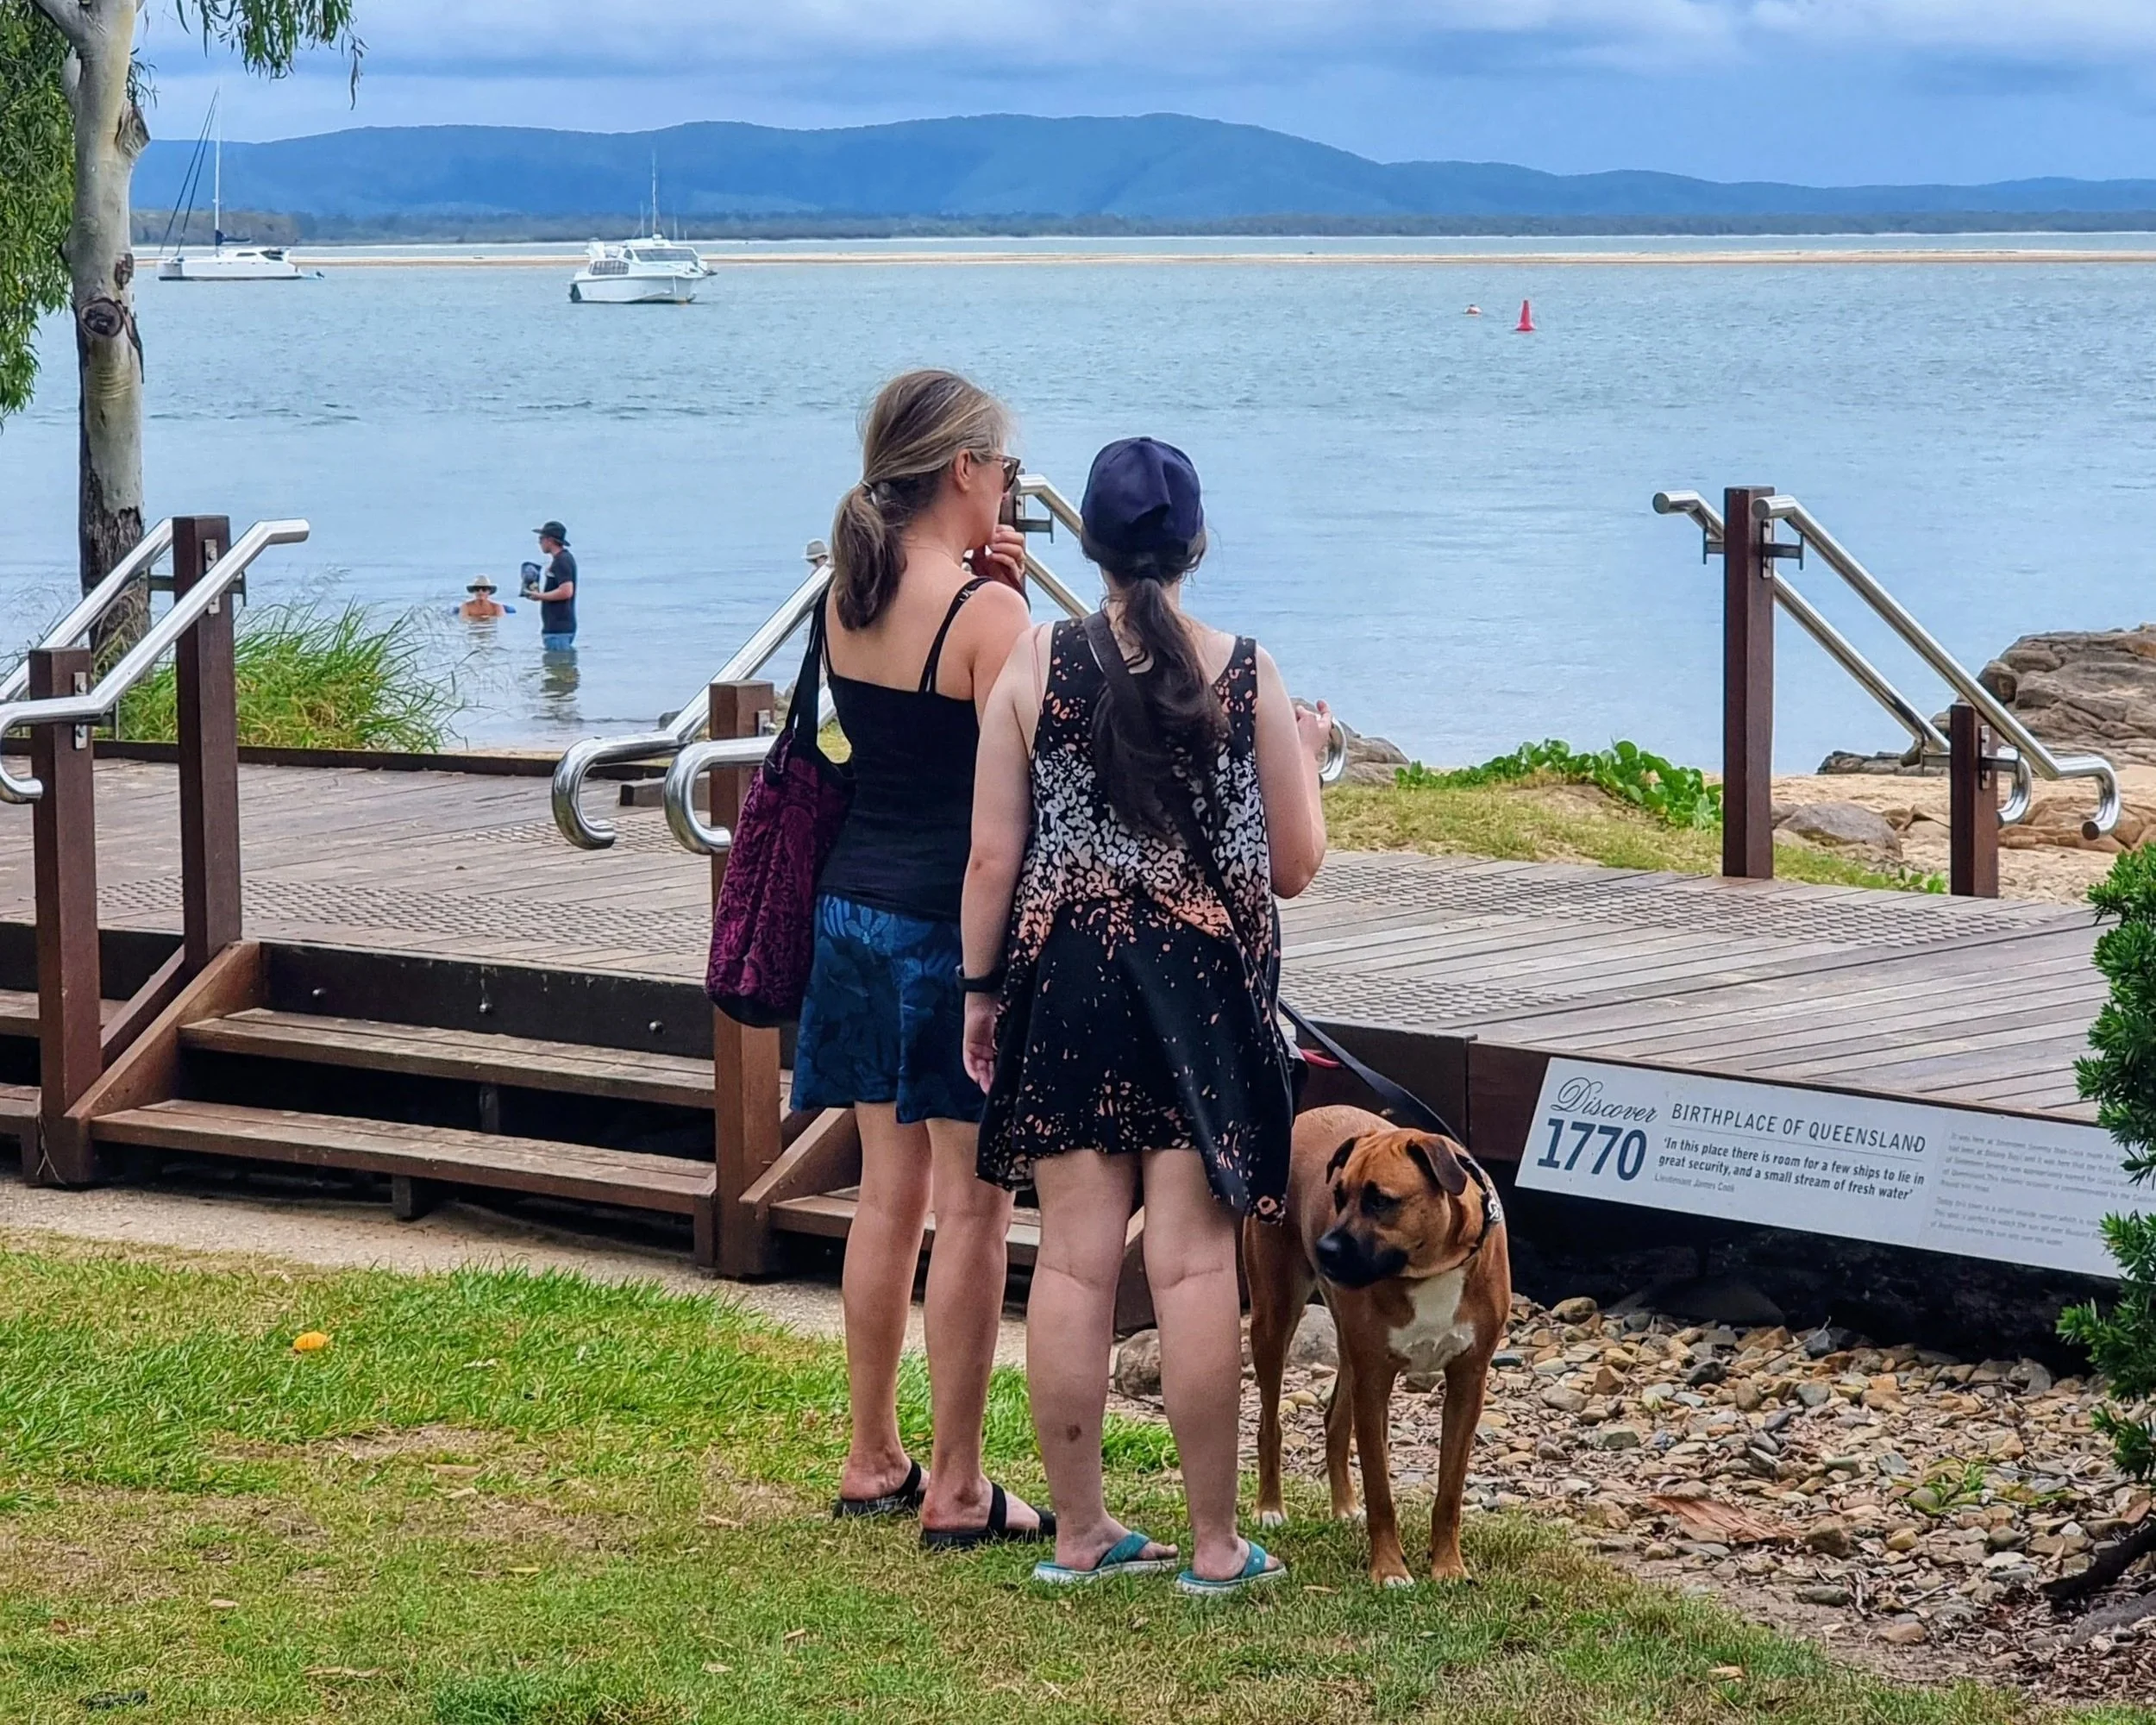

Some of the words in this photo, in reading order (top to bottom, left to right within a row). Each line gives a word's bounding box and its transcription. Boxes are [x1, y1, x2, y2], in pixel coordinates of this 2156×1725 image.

[1550, 1076, 1659, 1123] Discover
[1537, 1118, 1647, 1181] 1770
[1671, 1103, 1778, 1133] BIRTHPLACE
[1783, 1118, 1804, 1135] OF
[1808, 1121, 1926, 1152] QUEENSLAND
[1658, 1155, 1685, 1168] great
[1688, 1159, 1731, 1176] security,
[1733, 1165, 1753, 1177] and
[1755, 1169, 1761, 1178] a
[1764, 1170, 1793, 1183] small
[1794, 1173, 1830, 1189] stream
[1833, 1178, 1846, 1191] of
[1848, 1180, 1876, 1195] fresh
[1680, 1138, 1699, 1152] this
[1701, 1143, 1729, 1157] place
[1732, 1146, 1758, 1161] there
[1761, 1151, 1770, 1163] is
[1772, 1155, 1801, 1167] room
[1803, 1157, 1820, 1170] for
[1821, 1162, 1828, 1171] a
[1832, 1160, 1852, 1174] few
[1853, 1164, 1880, 1180] ships
[1883, 1169, 1895, 1182] to
[1897, 1170, 1911, 1182] lie
[1914, 1172, 1925, 1185] in
